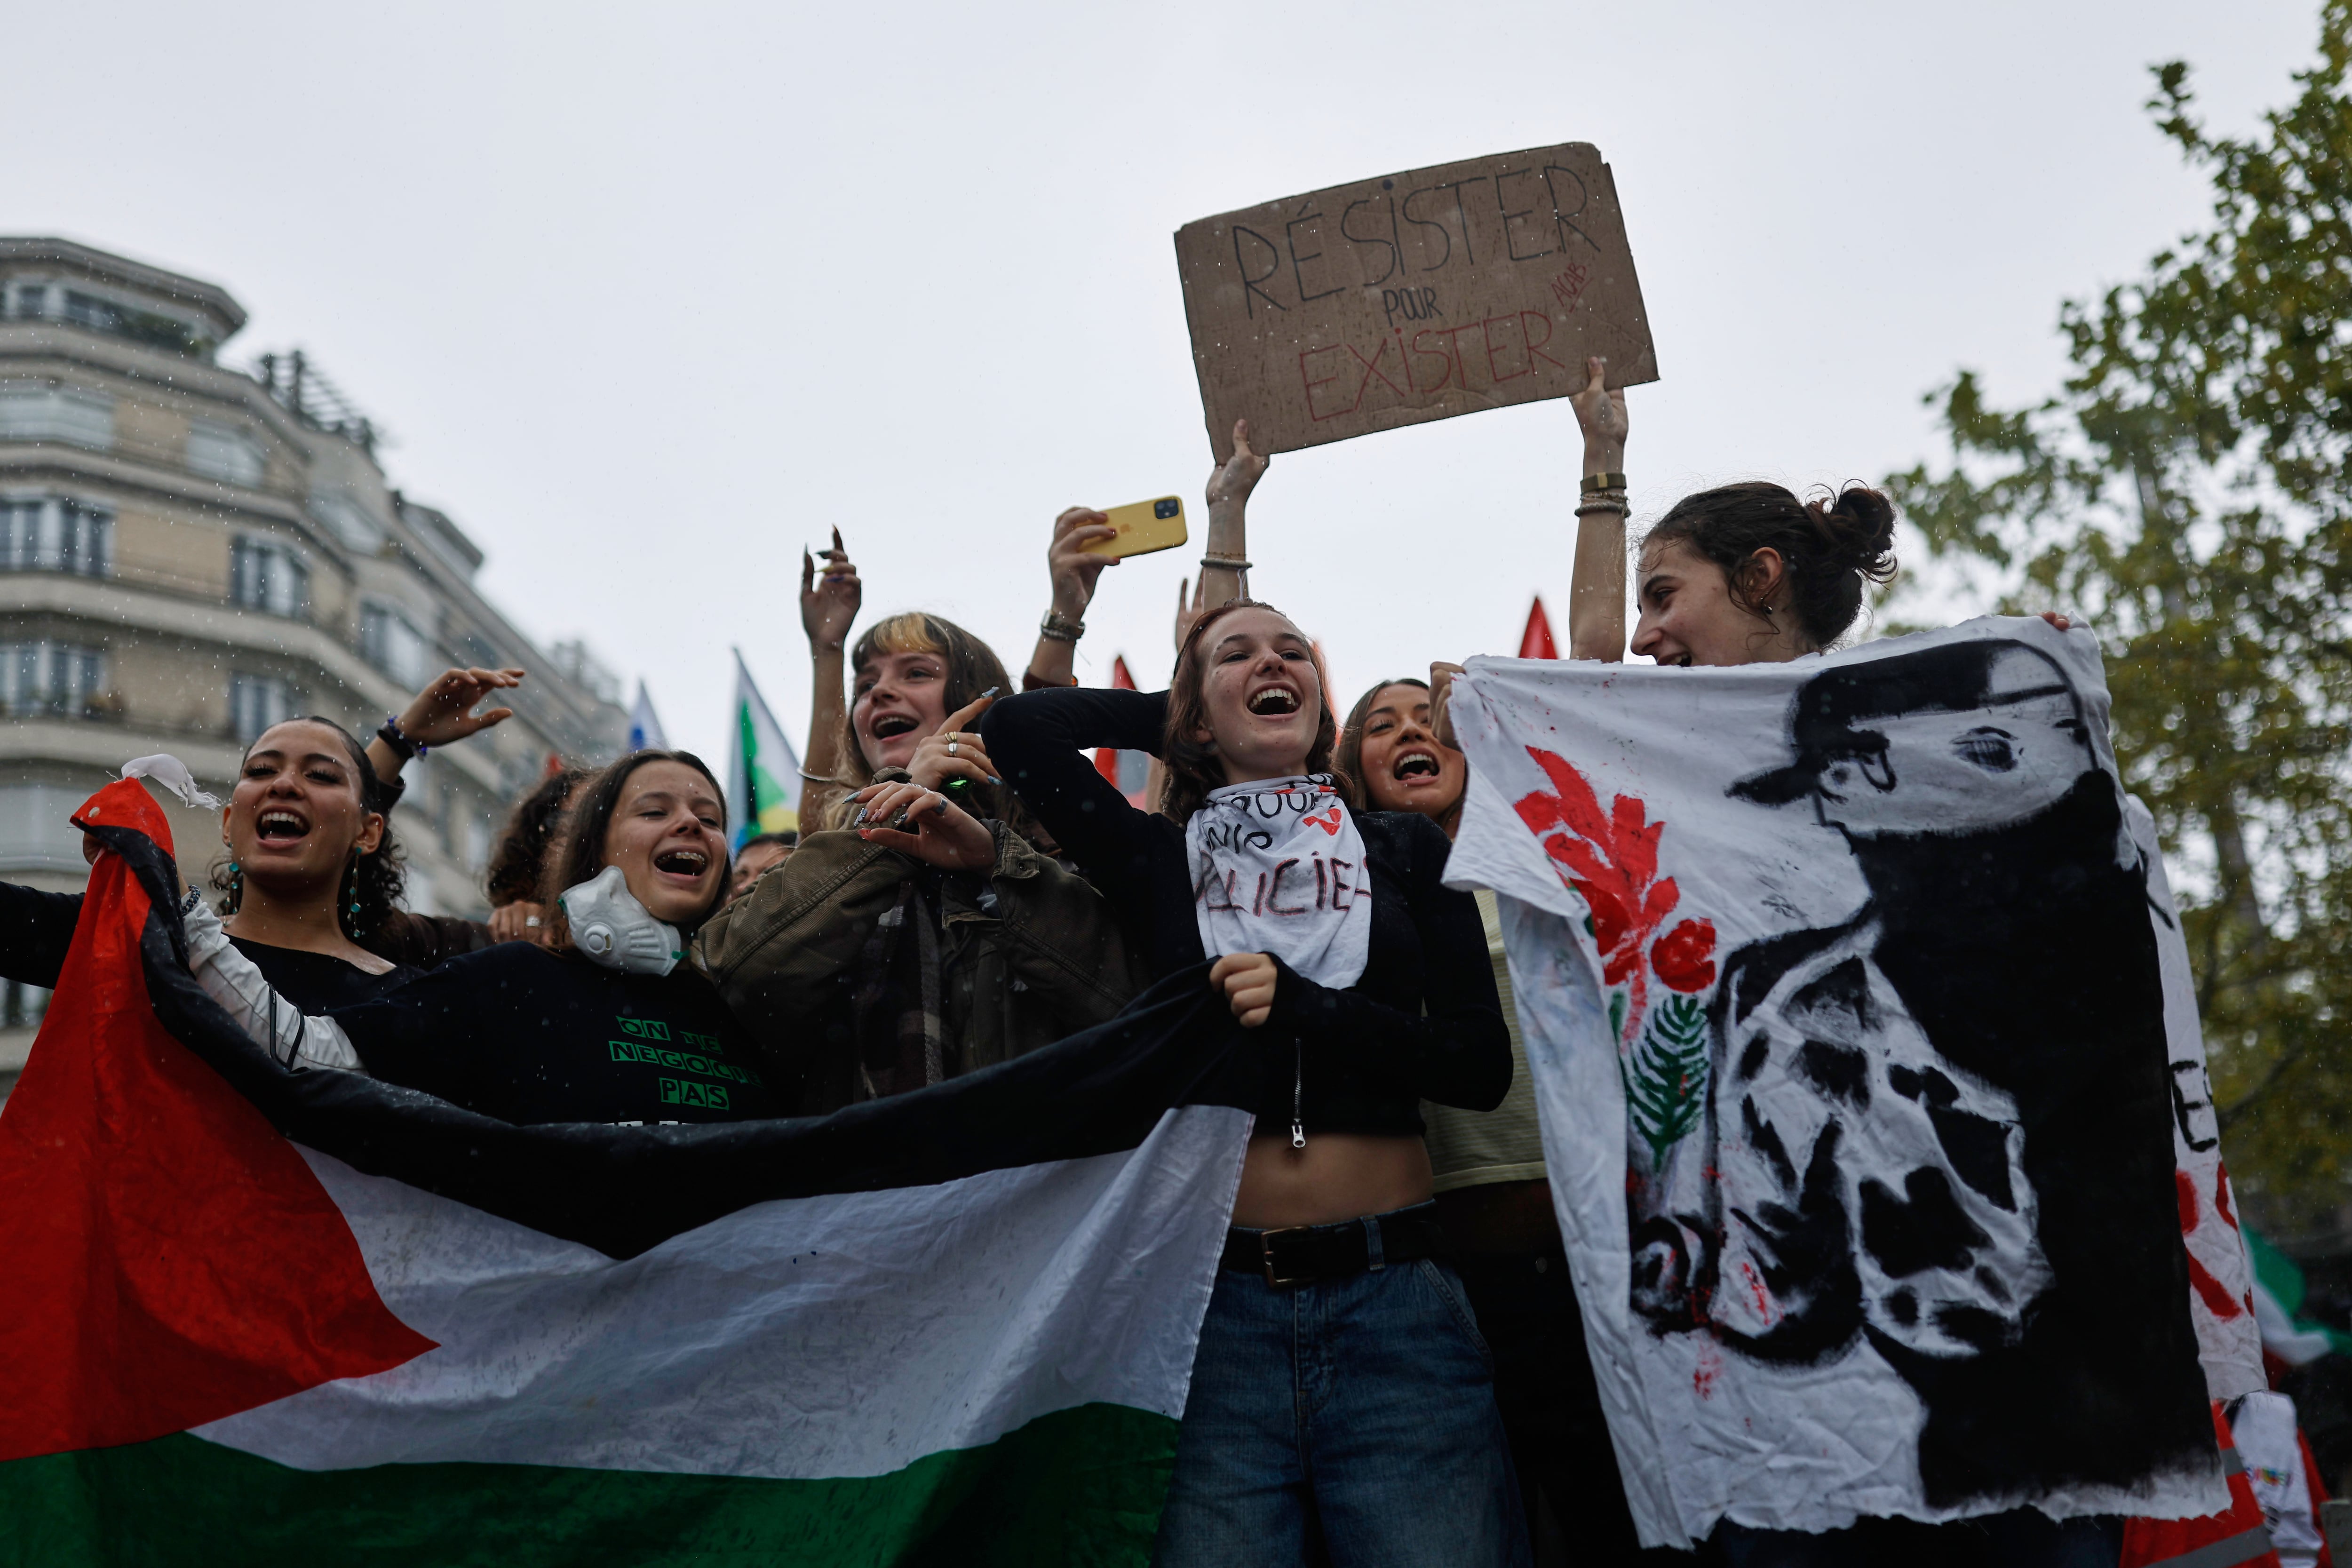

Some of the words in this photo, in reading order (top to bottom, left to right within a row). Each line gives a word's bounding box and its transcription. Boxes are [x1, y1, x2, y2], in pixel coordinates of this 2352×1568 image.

[1383, 288, 1443, 326] POUR
[616, 1016, 670, 1041] ON
[659, 1077, 729, 1110] PAS
